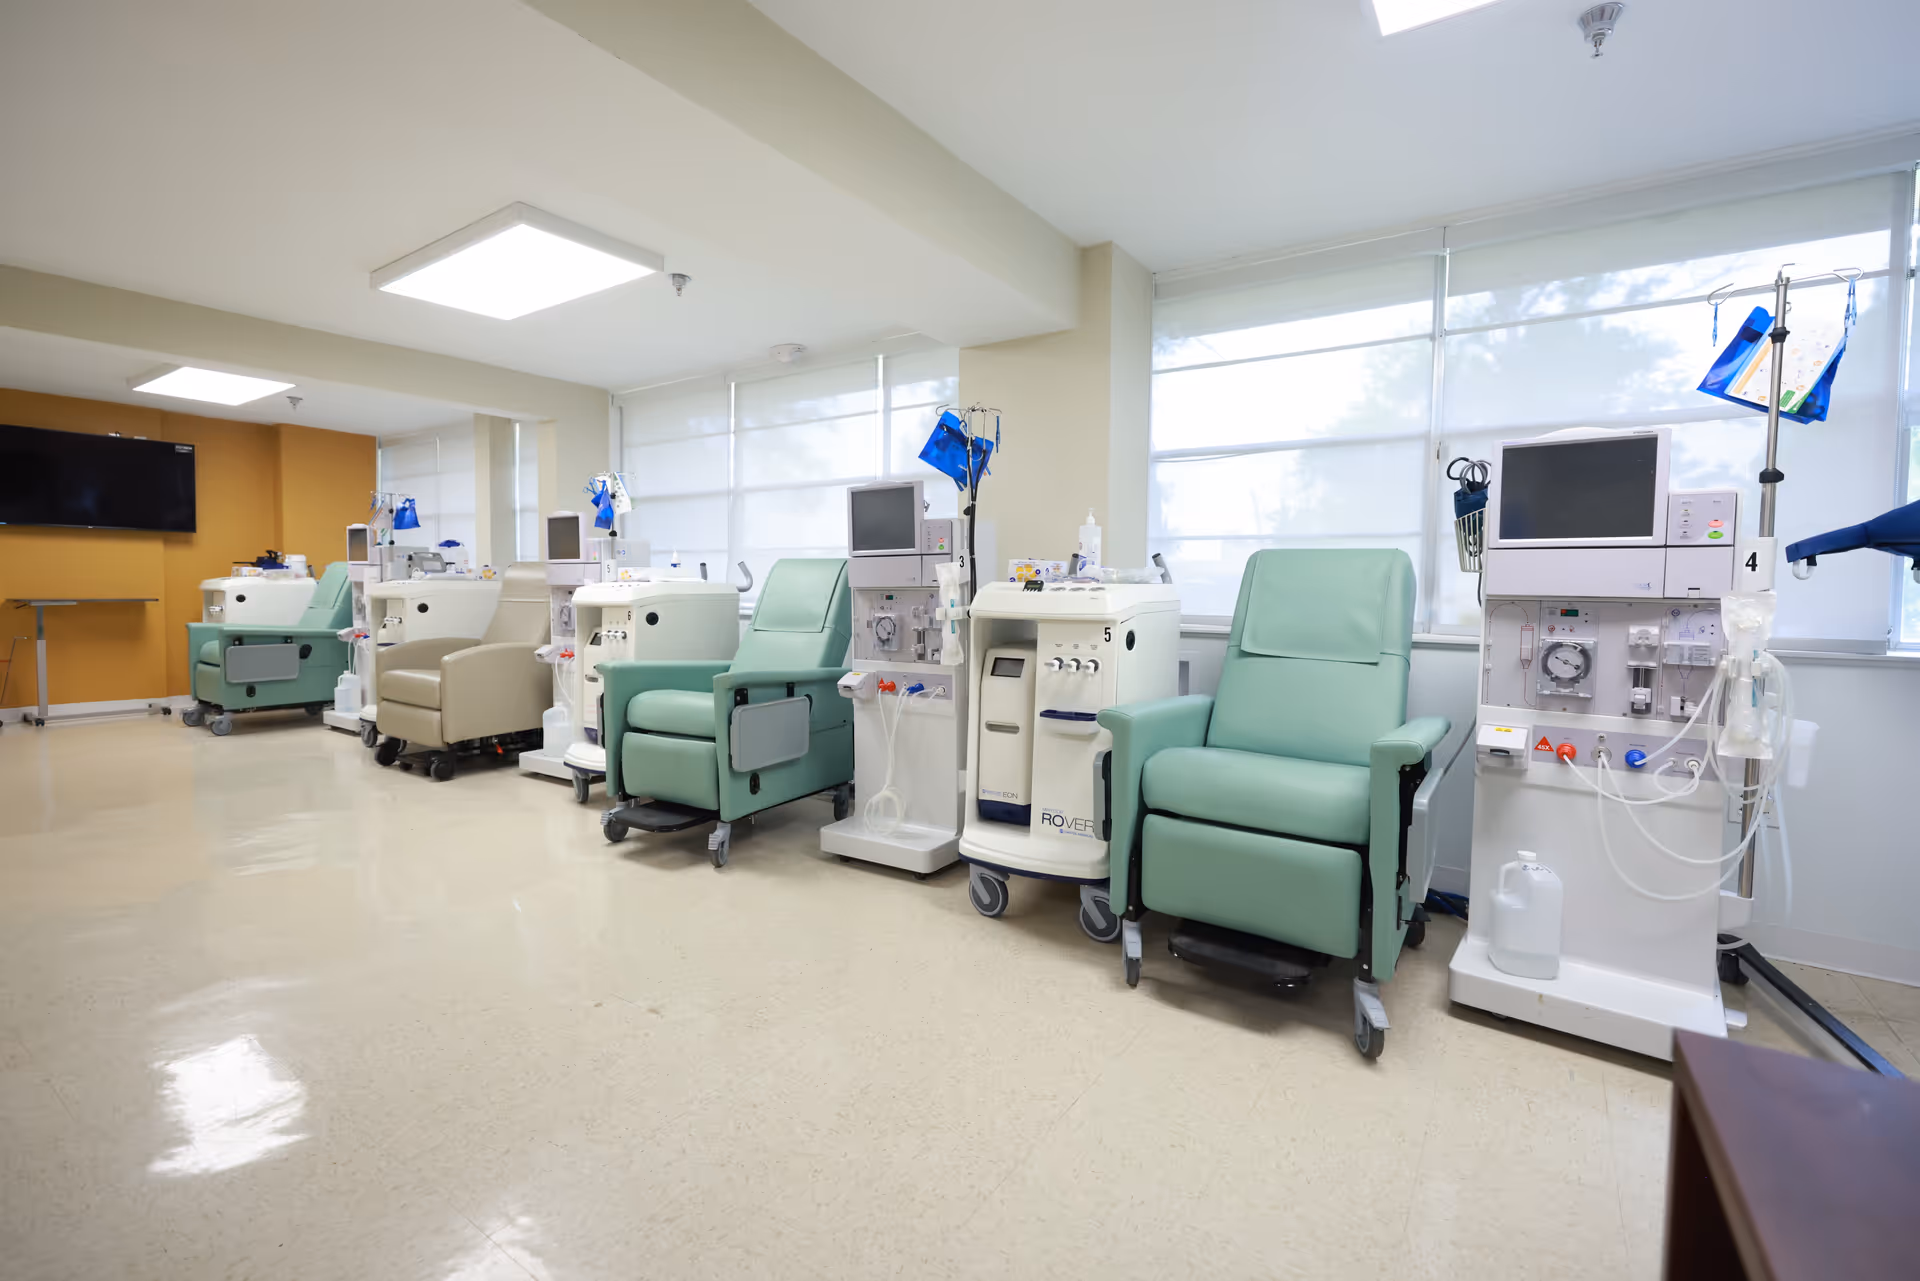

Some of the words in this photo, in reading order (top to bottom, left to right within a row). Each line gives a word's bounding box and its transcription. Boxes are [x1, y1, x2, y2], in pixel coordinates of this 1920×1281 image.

[959, 555, 964, 567] 3
[1745, 551, 1758, 572] 4
[627, 610, 632, 620] 6
[1104, 626, 1111, 642] 5
[1041, 812, 1094, 833] ROVER
